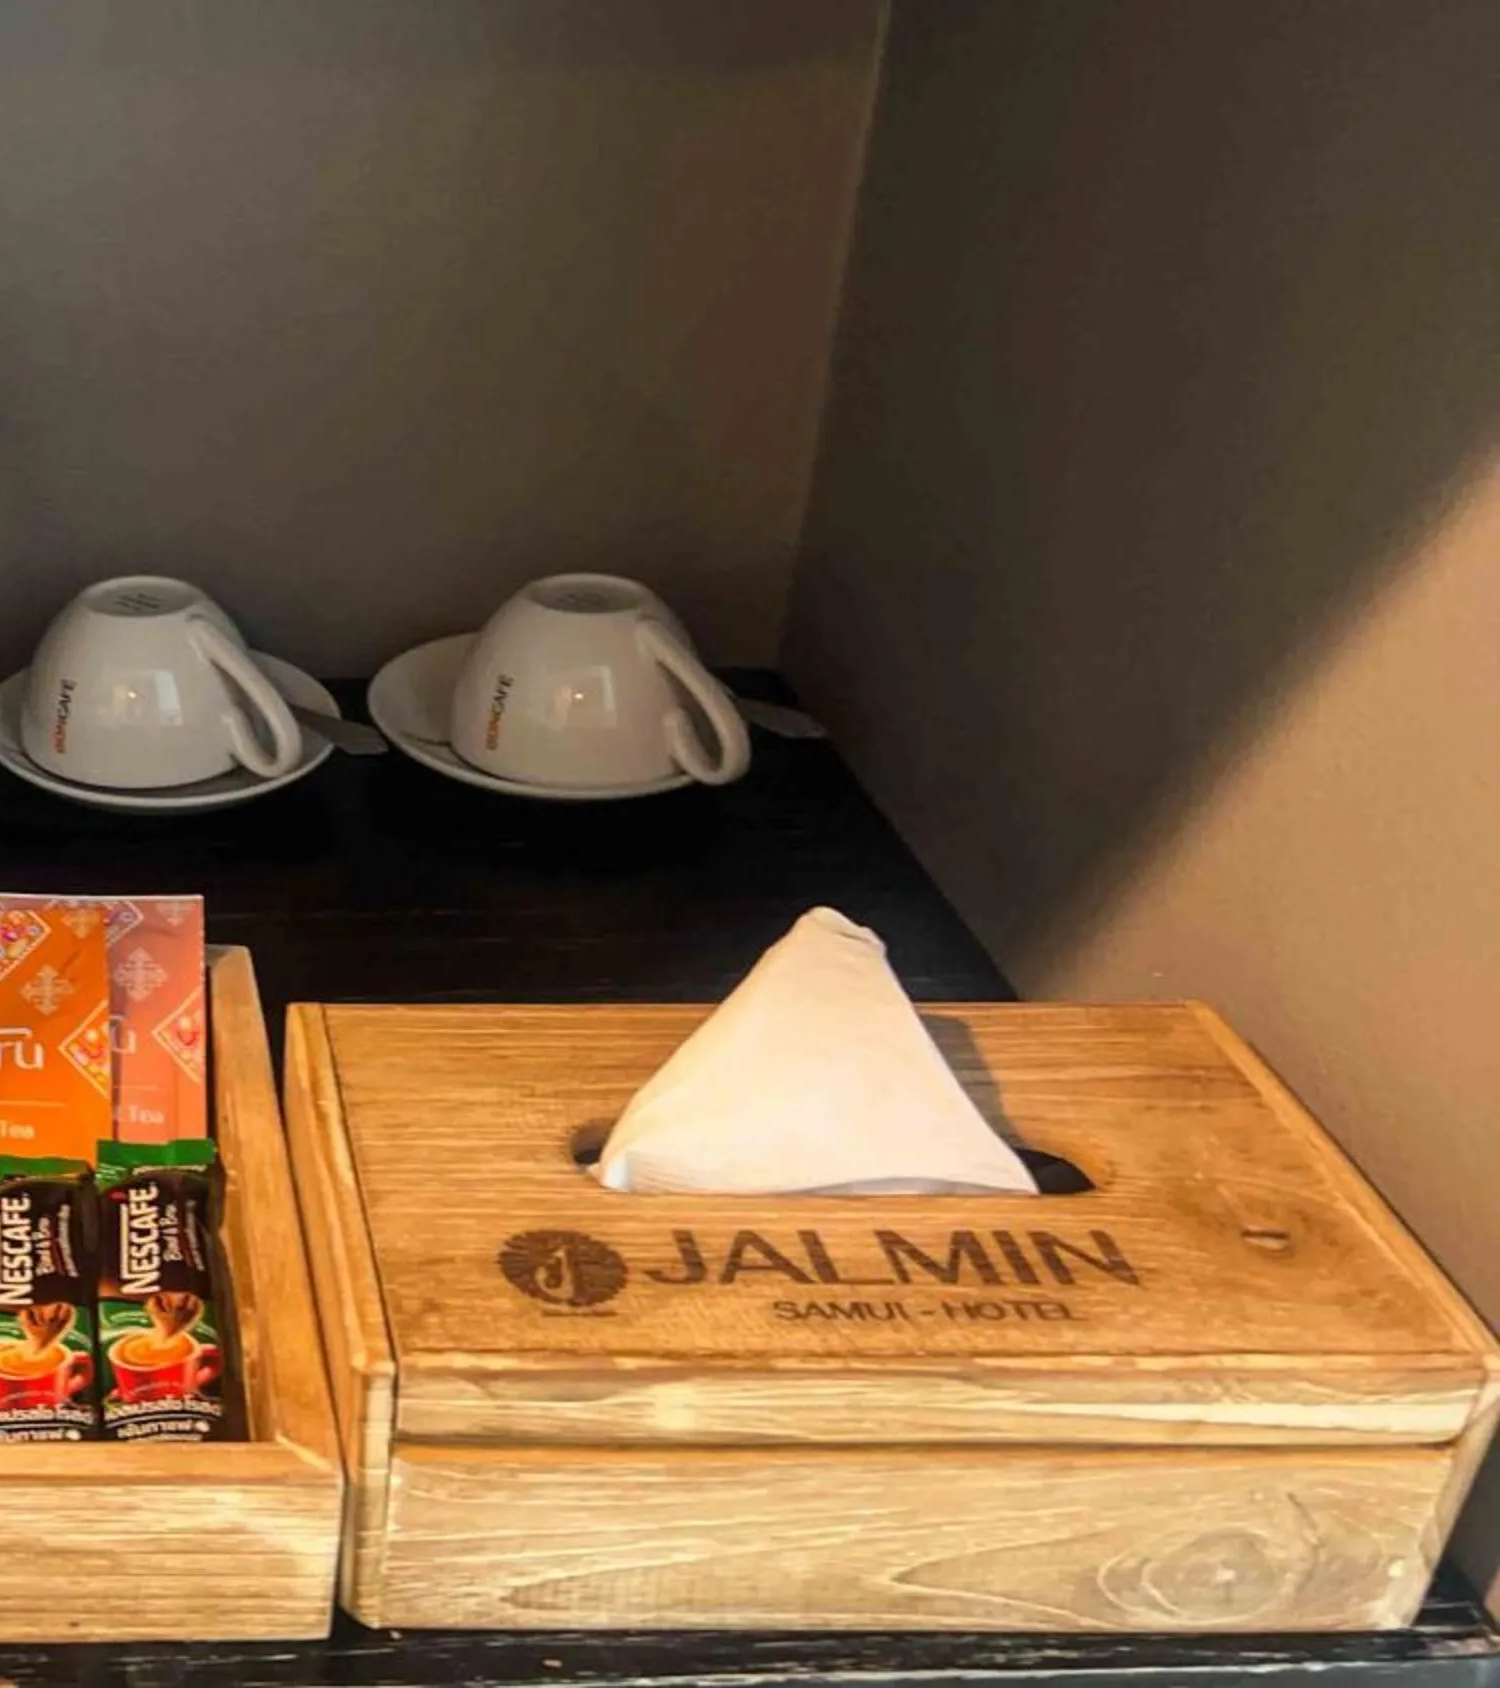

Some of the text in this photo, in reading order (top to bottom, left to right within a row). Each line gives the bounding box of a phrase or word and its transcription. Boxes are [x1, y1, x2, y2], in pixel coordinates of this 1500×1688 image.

[643, 1228, 1144, 1287] JALMIN
[773, 1301, 911, 1322] SAMUI
[941, 1300, 1090, 1322] HOTEL
